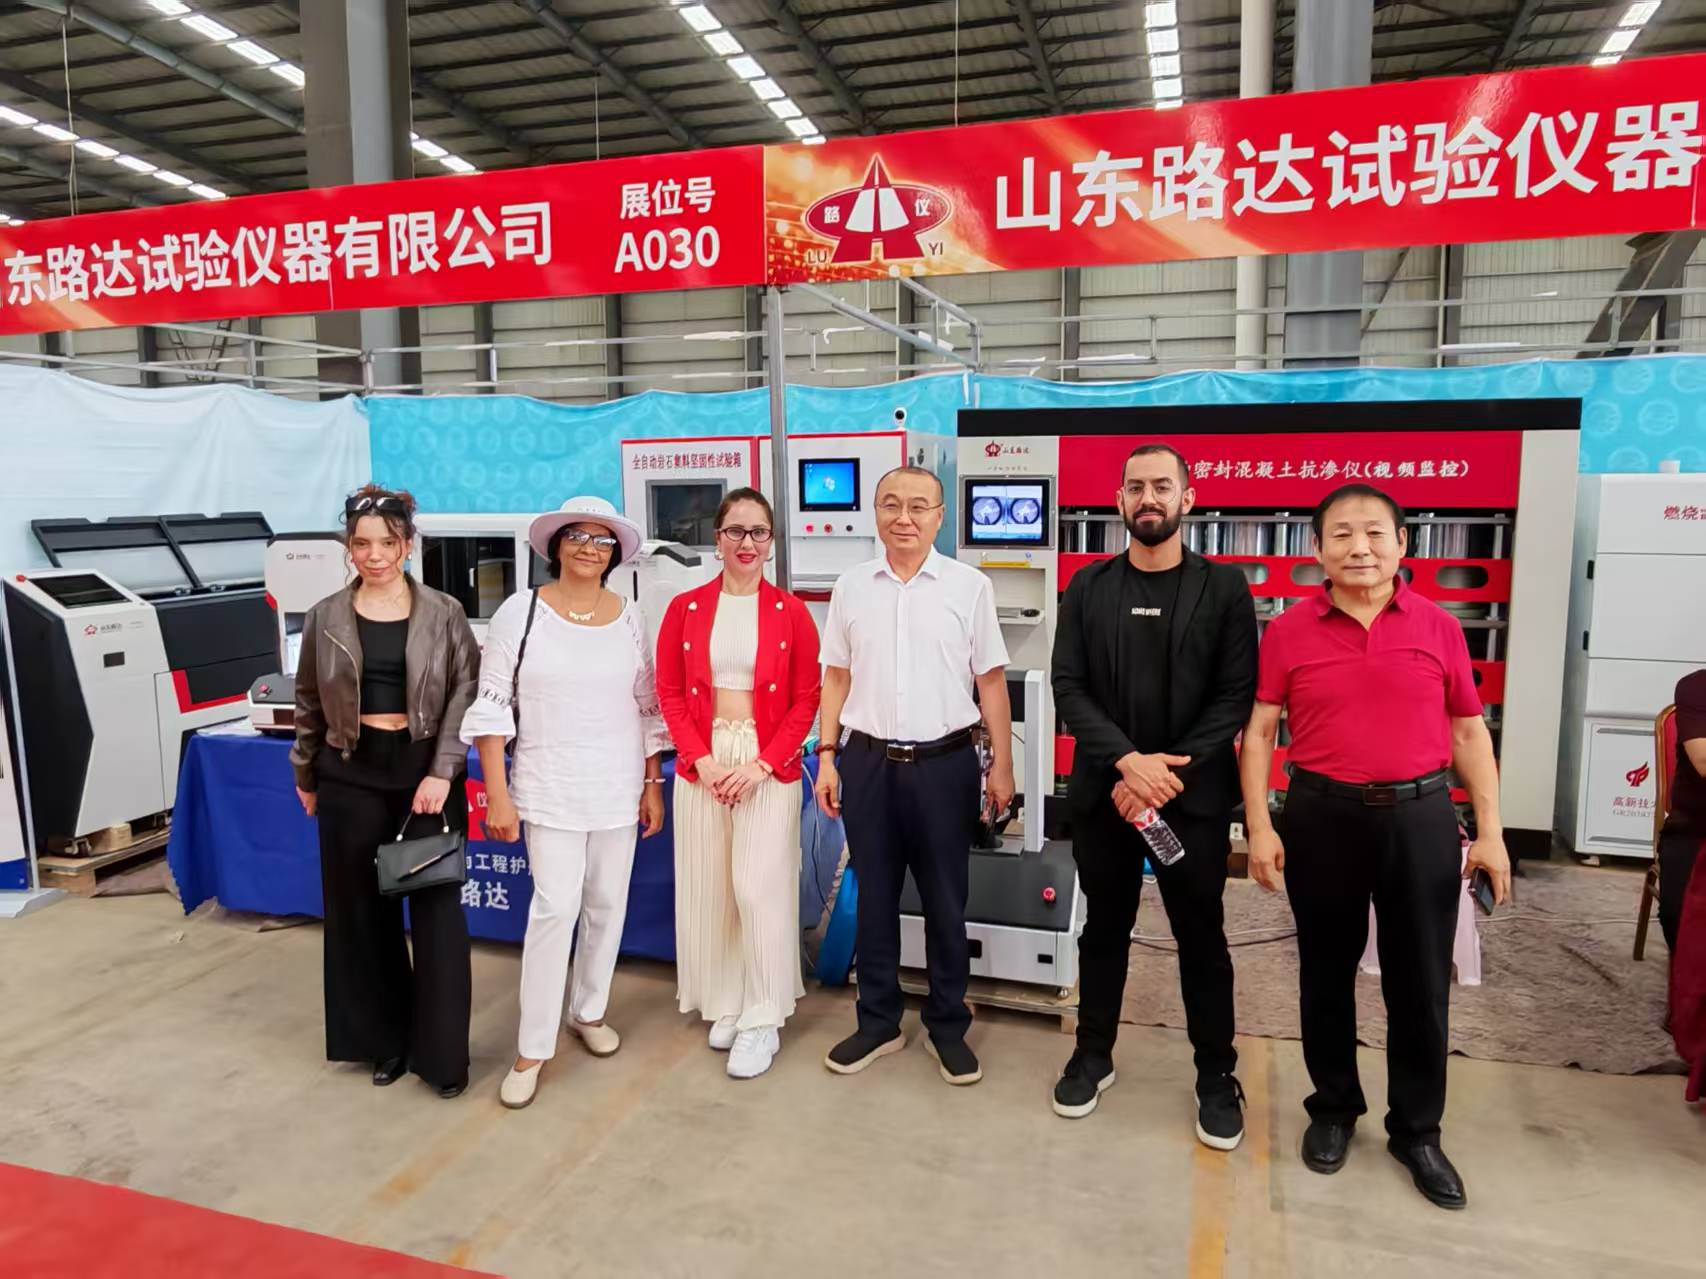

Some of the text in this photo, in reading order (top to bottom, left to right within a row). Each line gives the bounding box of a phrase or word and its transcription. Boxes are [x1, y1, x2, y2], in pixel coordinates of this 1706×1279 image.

[996, 101, 1704, 231] 山东路达试验仪器
[620, 176, 716, 220] 展位号
[915, 199, 931, 216] 仪
[0, 201, 552, 306] 东路达试验仪器有限公司
[614, 225, 720, 273] A030
[807, 242, 944, 264] LU YI
[1186, 459, 1470, 480] 密封混凝土抗渗仪(视频监控)
[465, 853, 532, 875] 工程护
[460, 878, 511, 911] 路达
